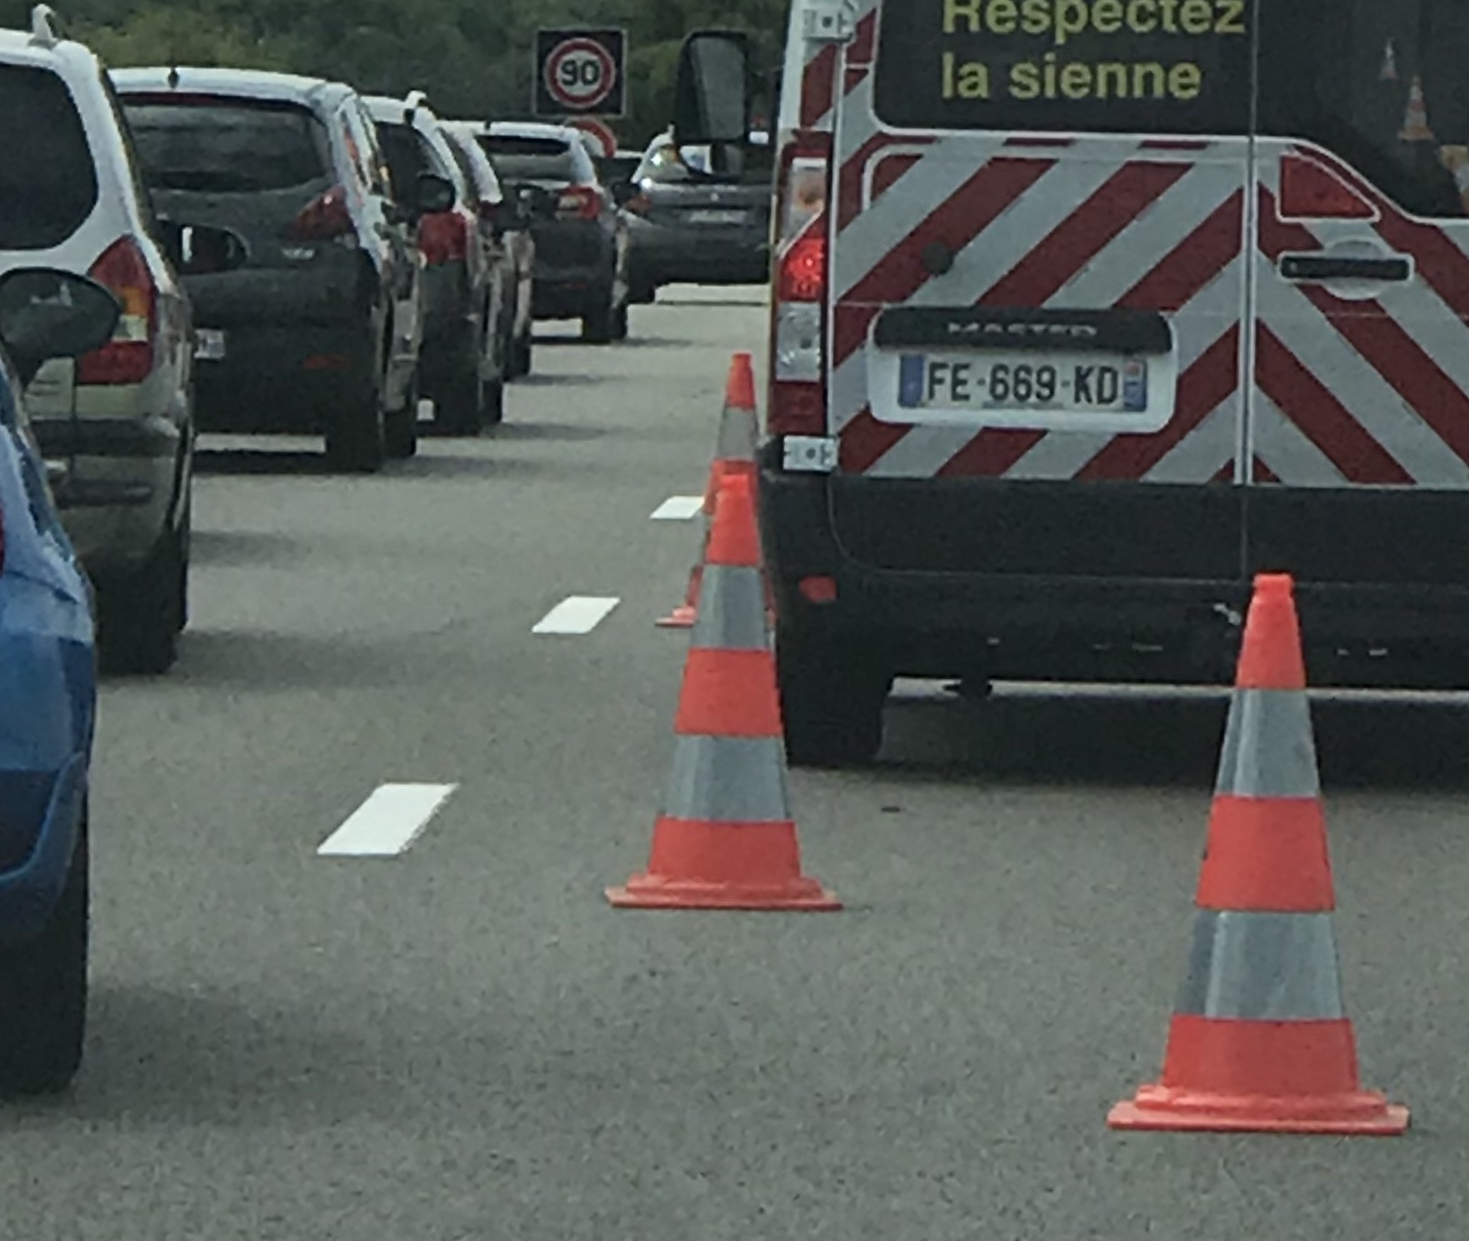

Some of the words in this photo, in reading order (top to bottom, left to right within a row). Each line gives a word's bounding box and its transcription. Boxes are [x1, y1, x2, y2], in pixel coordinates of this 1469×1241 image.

[560, 60, 600, 86] 90
[942, 52, 990, 100] la
[1008, 52, 1202, 100] sienne
[928, 361, 1119, 406] FE-669-KD
